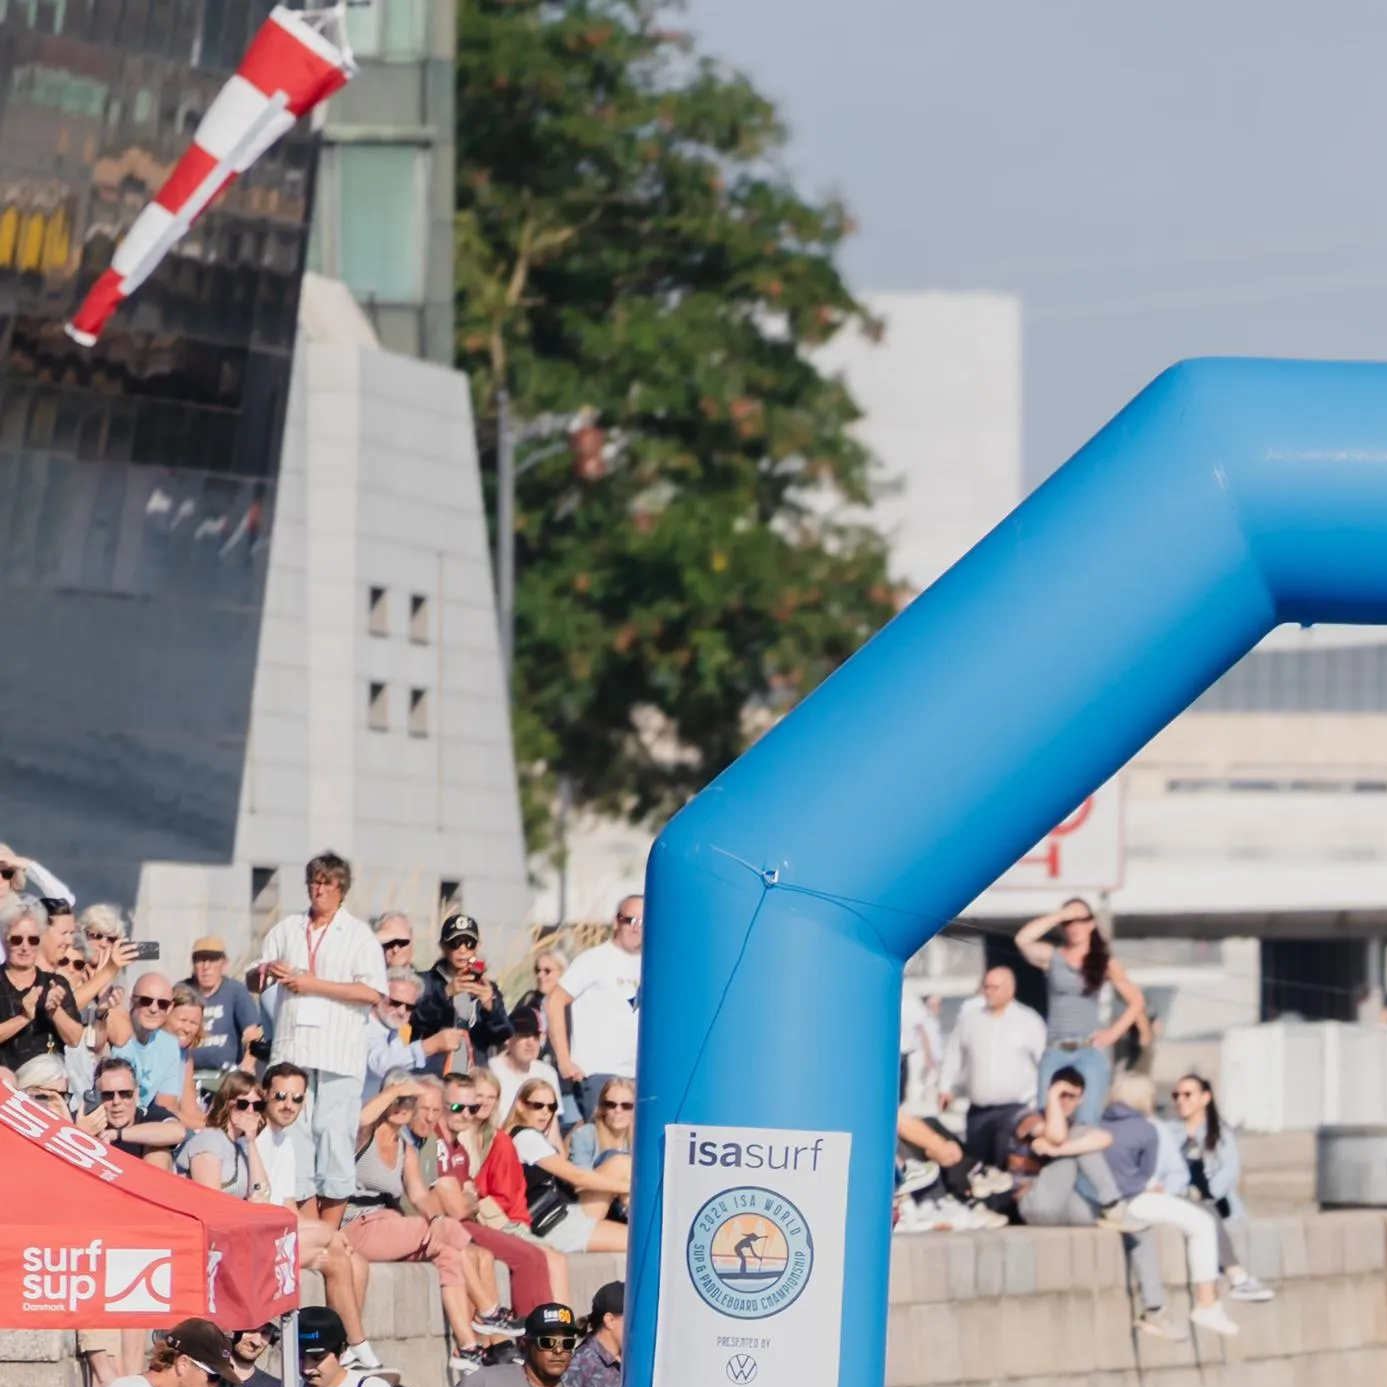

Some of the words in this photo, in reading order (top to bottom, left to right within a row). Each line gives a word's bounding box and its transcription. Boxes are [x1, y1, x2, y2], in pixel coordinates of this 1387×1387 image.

[688, 1131, 824, 1171] isasurf
[699, 1204, 728, 1233] 2024
[733, 1194, 756, 1209] ISA
[764, 1197, 802, 1236] WORLD
[22, 1239, 104, 1272] surf
[693, 1243, 705, 1262] SUP
[695, 1265, 706, 1274] &
[22, 1272, 96, 1312] sup
[700, 1274, 758, 1312] PADDLEBOARD
[760, 1250, 807, 1310] CHAMPIONSHIP
[22, 1301, 66, 1312] Danmark
[716, 1336, 759, 1349] PRESENTED
